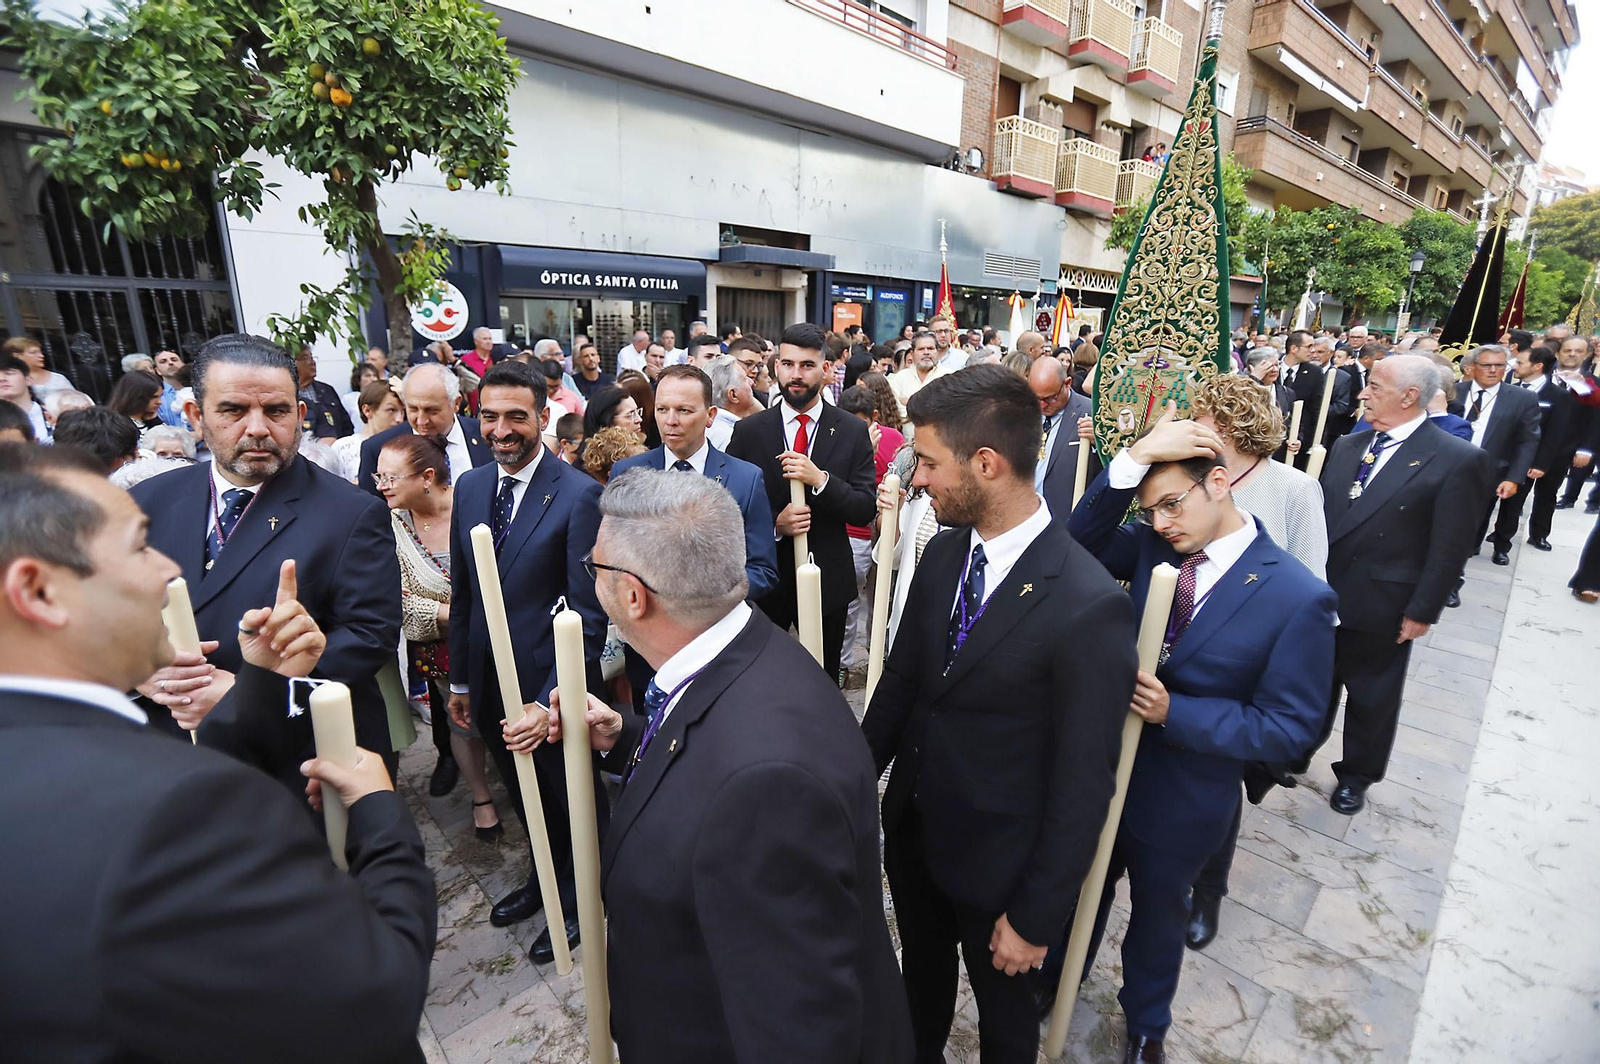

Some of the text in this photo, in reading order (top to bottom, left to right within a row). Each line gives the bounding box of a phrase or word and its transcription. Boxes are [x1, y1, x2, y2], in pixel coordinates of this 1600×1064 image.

[540, 270, 679, 290] ÓPTICA SANTA OTILIA
